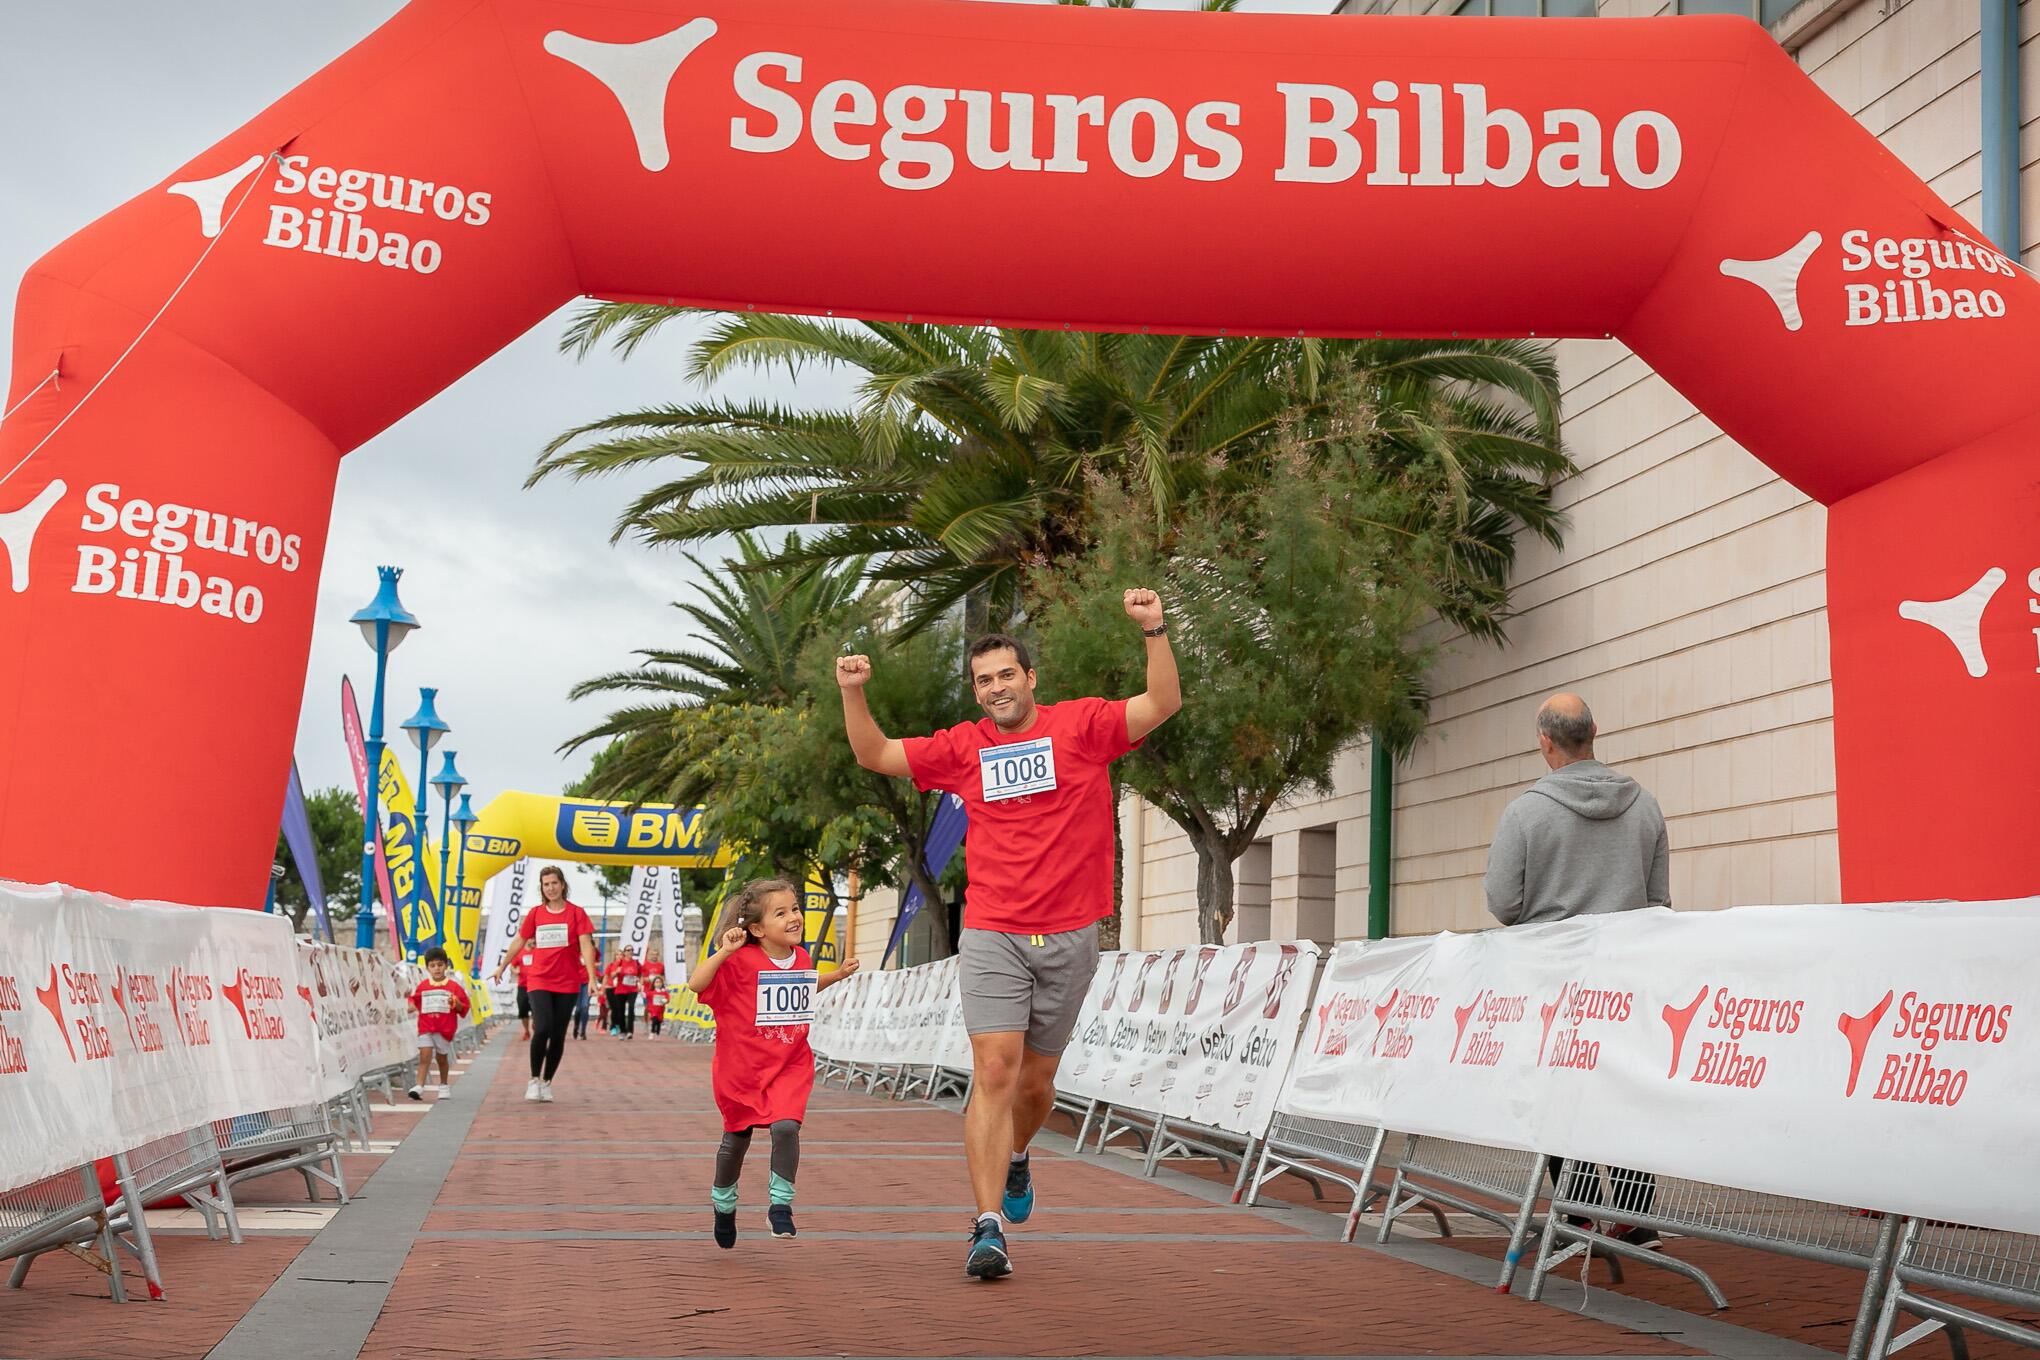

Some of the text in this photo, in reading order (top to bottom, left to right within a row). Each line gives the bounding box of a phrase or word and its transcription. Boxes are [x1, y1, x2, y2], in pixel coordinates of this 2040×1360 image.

[730, 51, 1682, 190] Seguros Bilbao
[273, 155, 491, 226] Seguros
[262, 204, 442, 274] Bilbao
[1841, 229, 2016, 279] Seguros
[1844, 279, 2006, 326] Bilbao
[81, 483, 301, 572] Seguros
[71, 545, 263, 624] Bilbao
[991, 754, 1047, 786] 1008
[487, 838, 518, 855] BM
[627, 813, 703, 849] BM
[506, 860, 526, 938] CORRE
[762, 984, 810, 1012] 1008
[1478, 989, 1528, 1030] Seguros
[1708, 987, 1805, 1041] Seguros
[1893, 991, 2013, 1052] Seguros
[75, 1015, 114, 1061] Bilba
[249, 1008, 286, 1040] Bilbao
[1240, 1025, 1278, 1069] Getxo
[1461, 1031, 1505, 1067] Bilbao
[1548, 1028, 1601, 1071] Bilbao
[1691, 1041, 1767, 1089] Bilbao
[1873, 1053, 1969, 1108] Bilbao
